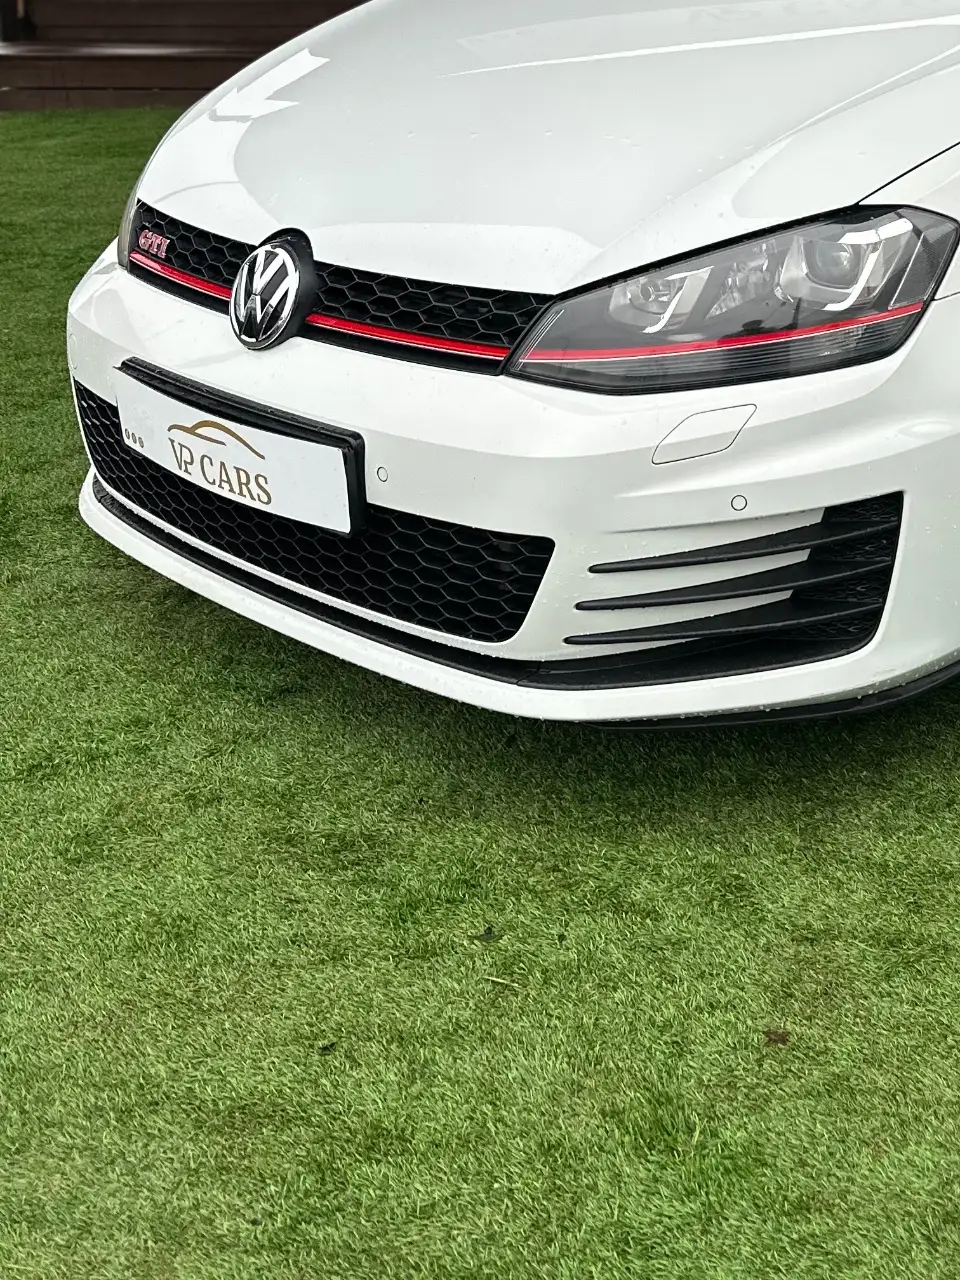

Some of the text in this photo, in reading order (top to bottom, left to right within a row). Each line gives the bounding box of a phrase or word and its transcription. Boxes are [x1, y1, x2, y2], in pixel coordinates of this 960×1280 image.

[138, 230, 171, 259] GTI
[168, 437, 273, 505] VP CARS
